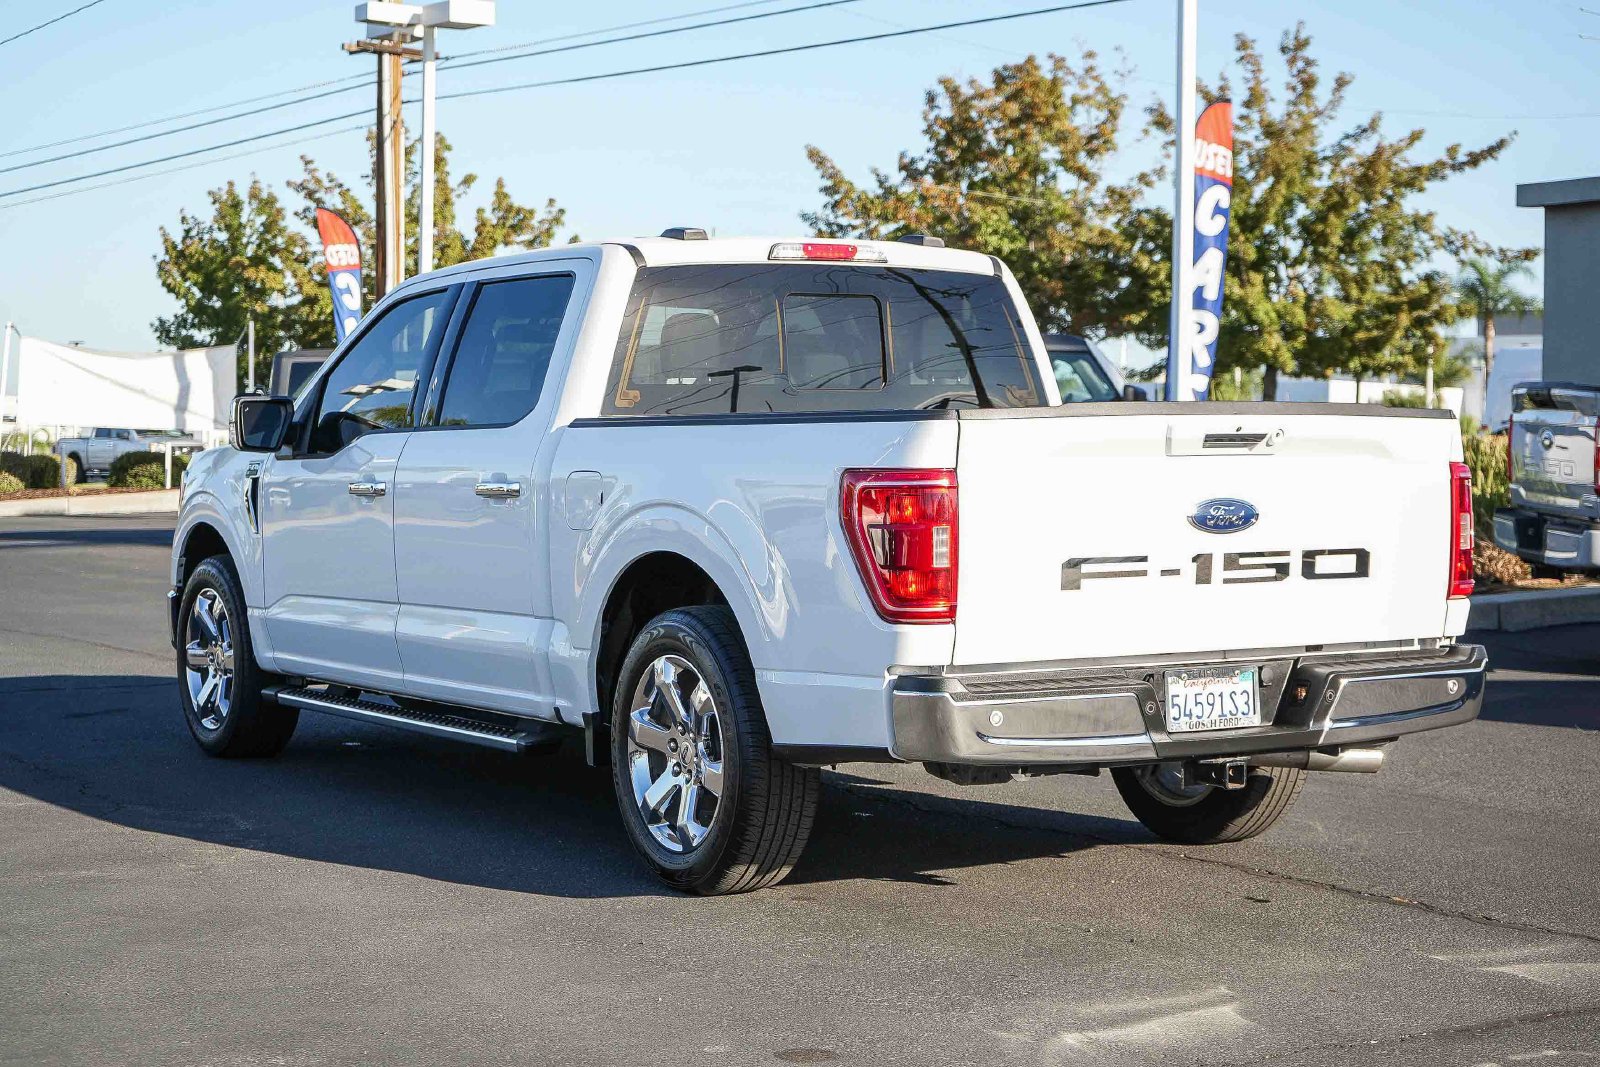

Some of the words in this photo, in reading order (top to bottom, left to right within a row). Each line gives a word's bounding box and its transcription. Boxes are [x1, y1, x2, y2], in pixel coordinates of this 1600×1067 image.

[1206, 505, 1245, 527] Ford
[1061, 547, 1371, 591] F-150
[1171, 689, 1251, 722] 54591S3
